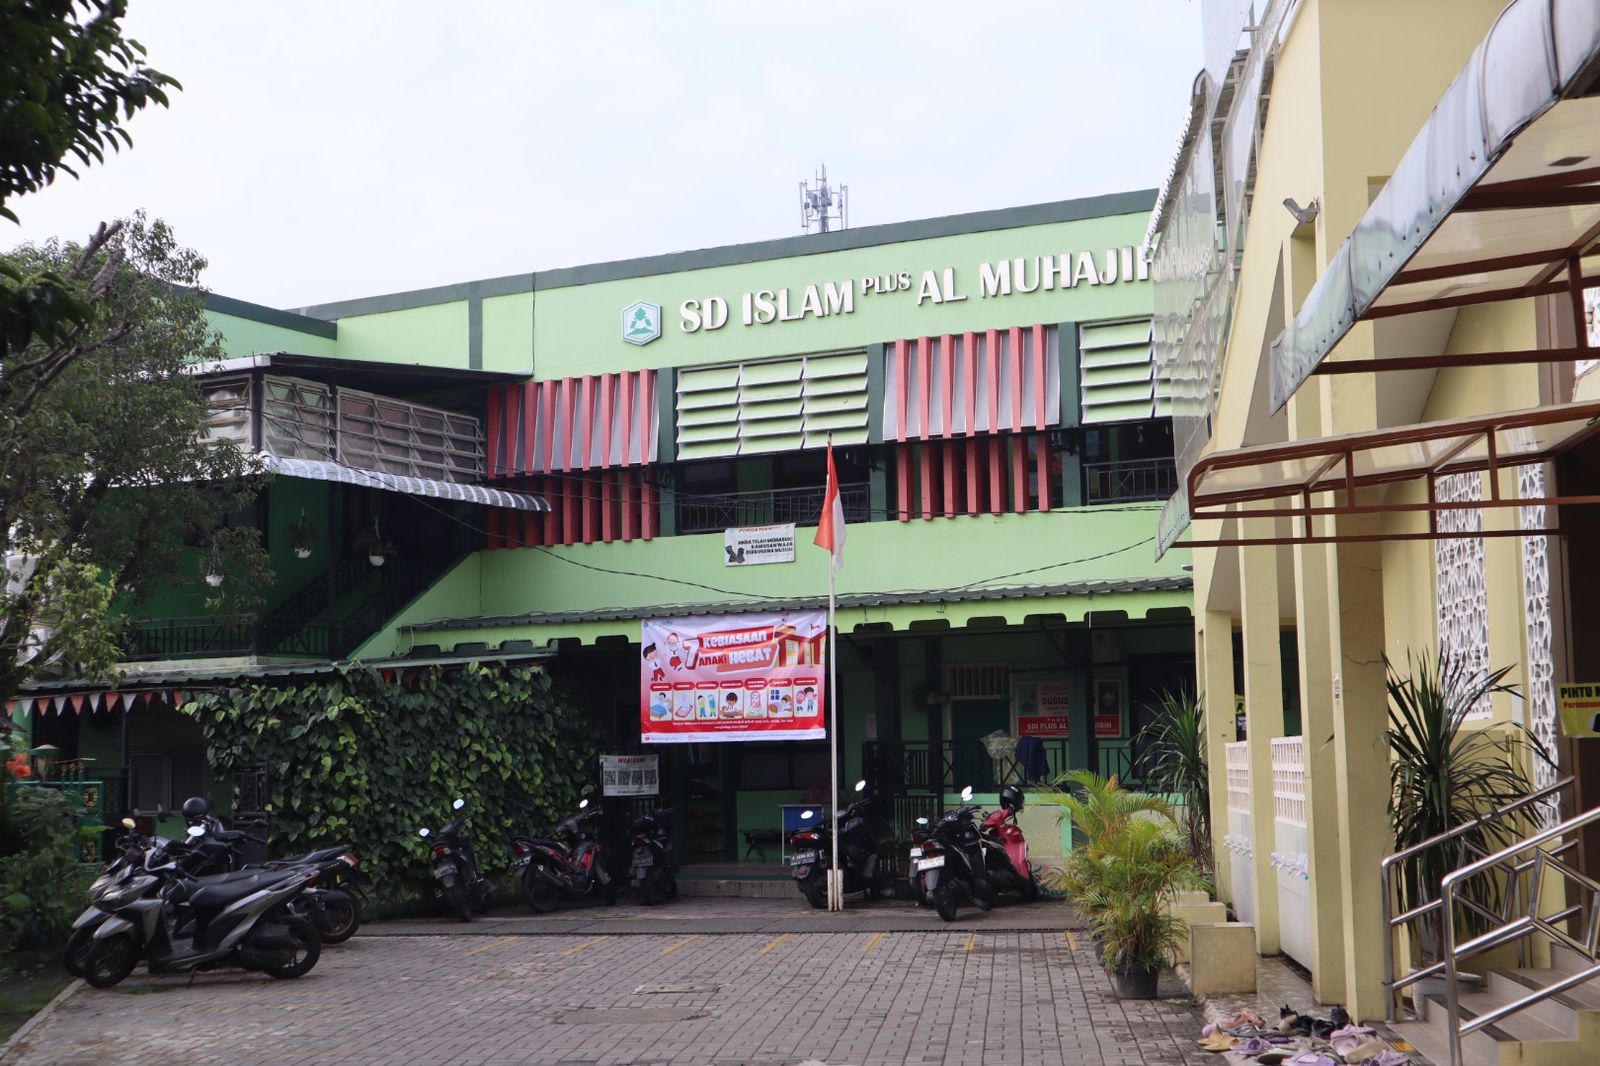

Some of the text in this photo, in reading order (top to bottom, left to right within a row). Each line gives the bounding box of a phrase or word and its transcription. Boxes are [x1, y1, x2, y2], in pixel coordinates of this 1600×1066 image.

[680, 297, 729, 334] SD
[742, 279, 855, 326] ISLAM
[861, 272, 912, 296] PLUS
[917, 267, 968, 306] AL
[682, 638, 700, 670] 7
[1560, 687, 1593, 698] PINTU
